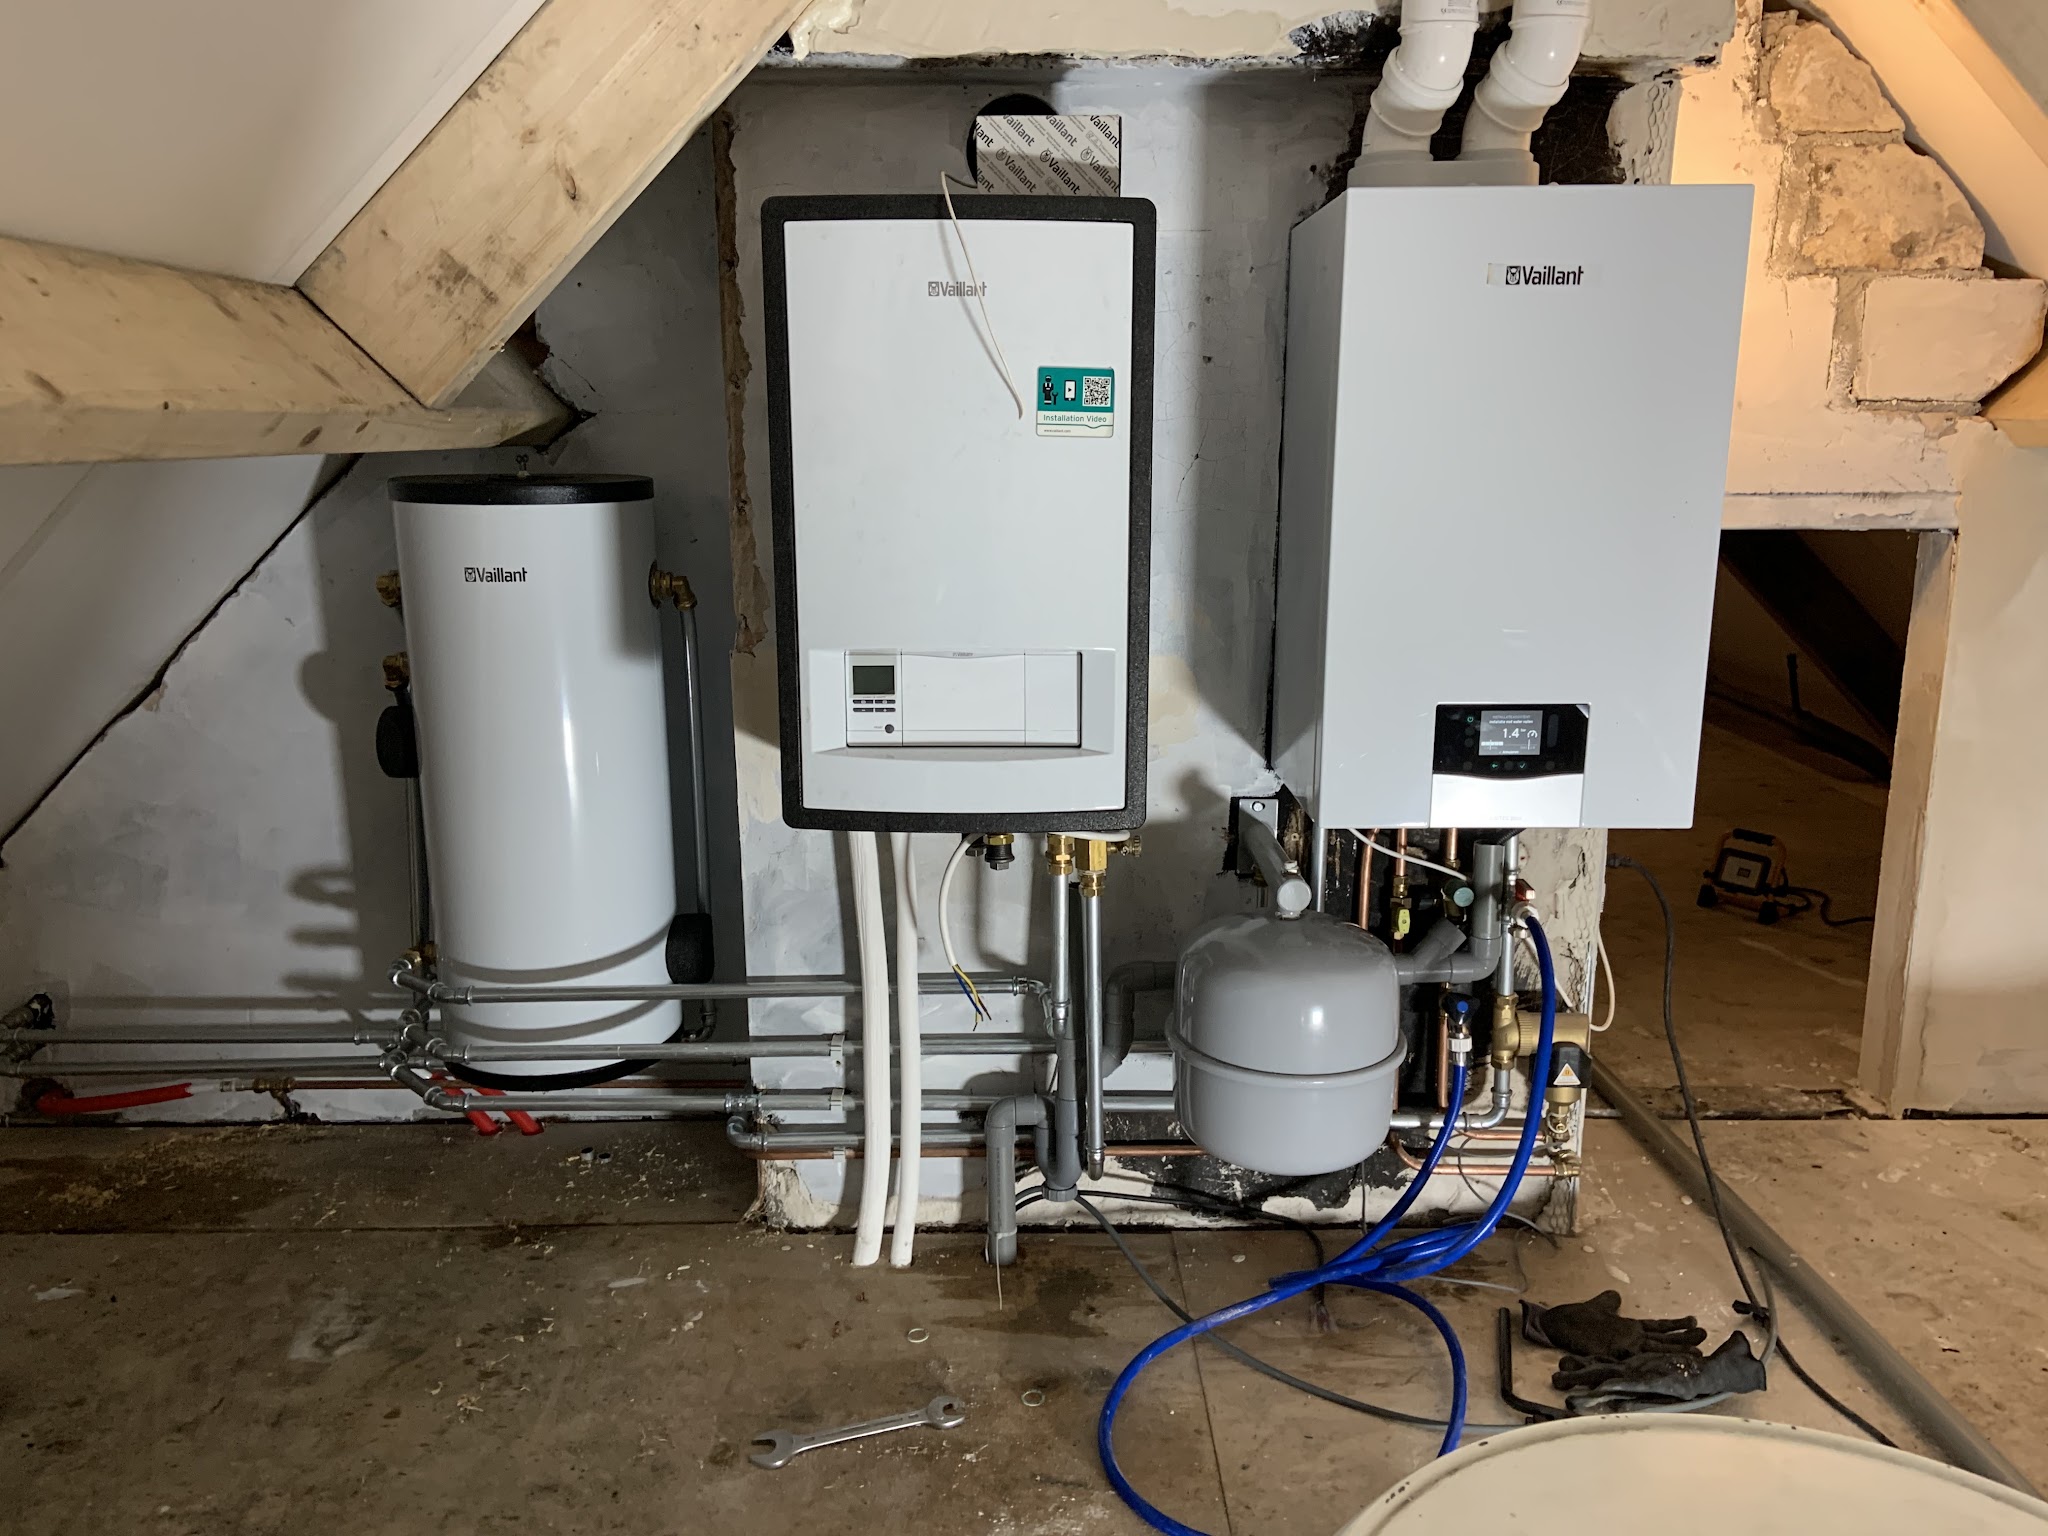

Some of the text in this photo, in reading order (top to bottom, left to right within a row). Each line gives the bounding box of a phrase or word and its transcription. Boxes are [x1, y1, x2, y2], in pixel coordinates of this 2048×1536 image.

[1004, 155, 1037, 193] Vaillant
[1048, 157, 1081, 195] Vaillant
[1522, 265, 1584, 285] Vaillant
[1043, 414, 1107, 423] Installation Video
[476, 567, 528, 583] Vaillant
[1503, 727, 1520, 738] 1.4
